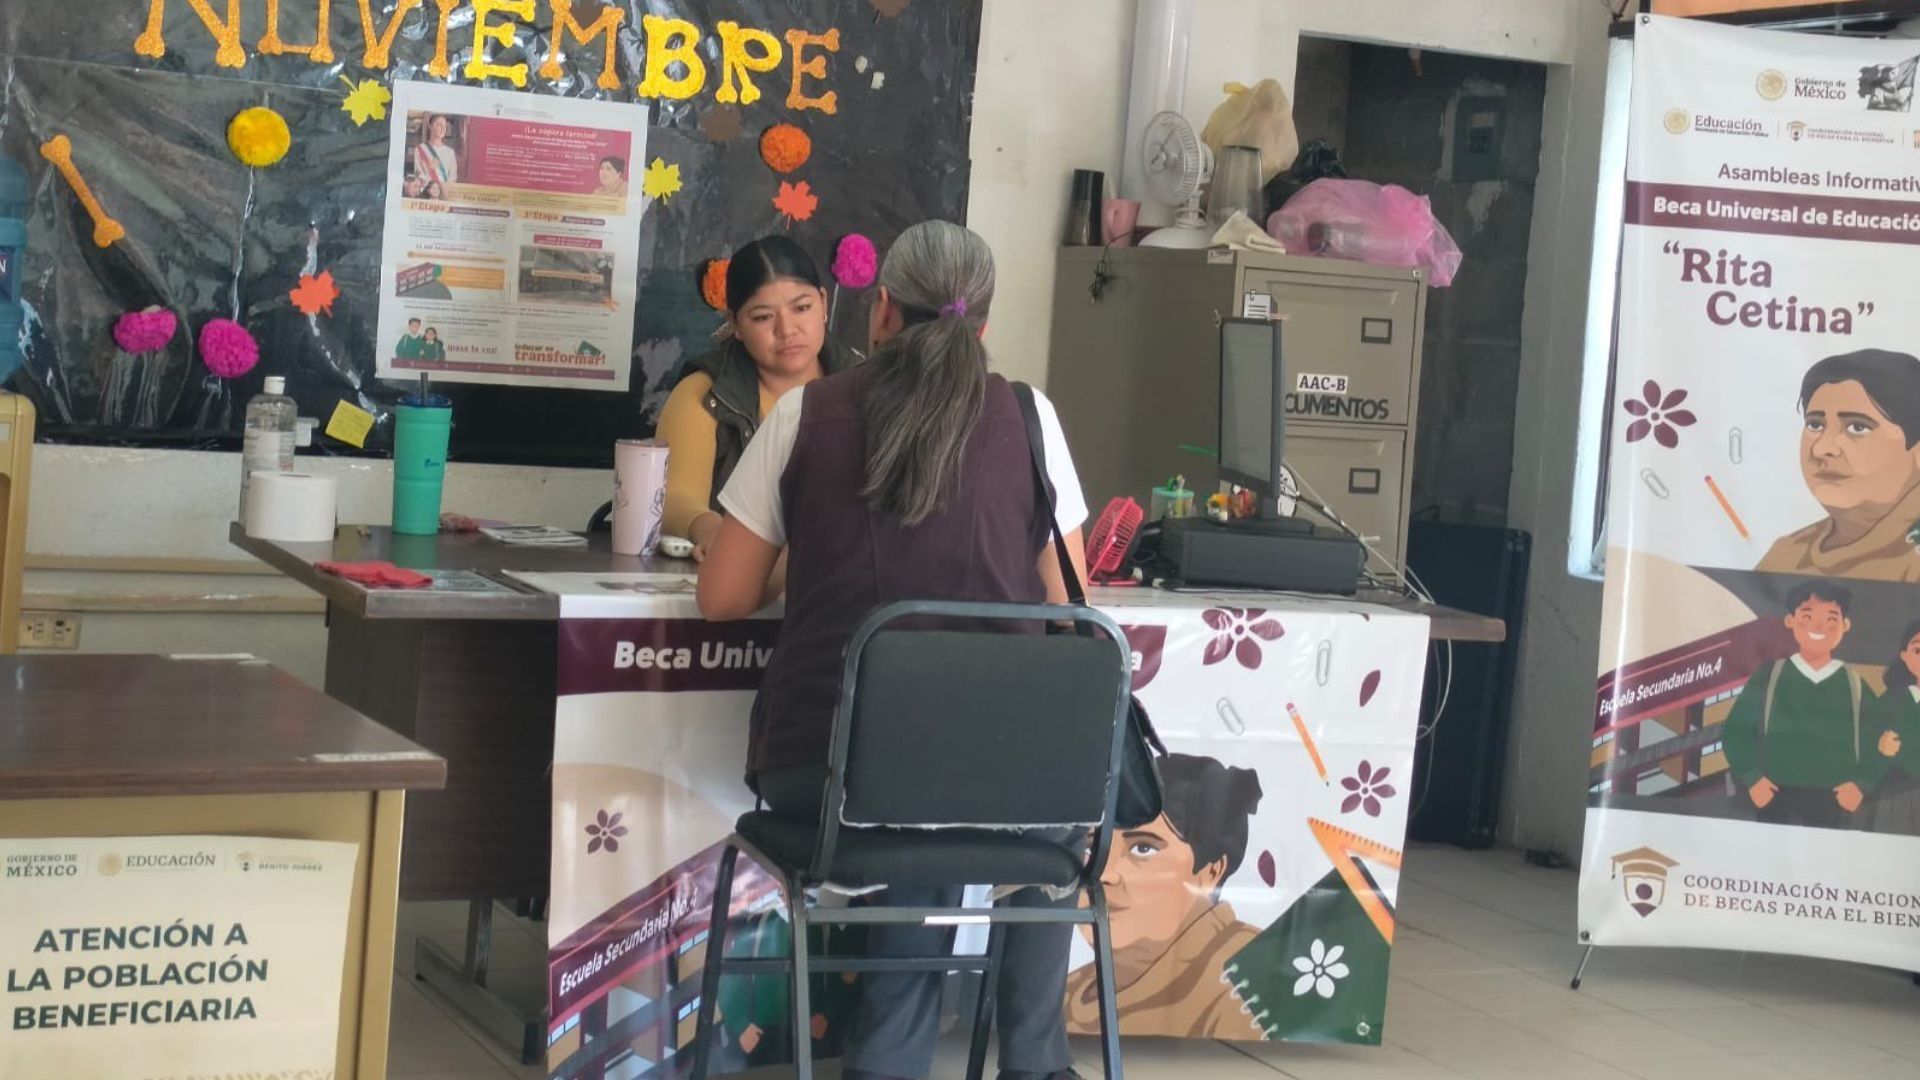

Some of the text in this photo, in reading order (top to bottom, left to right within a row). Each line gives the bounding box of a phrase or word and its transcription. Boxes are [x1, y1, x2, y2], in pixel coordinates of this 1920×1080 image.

[1794, 77, 1846, 88] Gobierno de
[1794, 85, 1847, 100] México
[1695, 115, 1762, 131] Educación
[1718, 163, 1820, 187] Asambleas
[1654, 196, 1920, 231] Beca Universal de Educació
[1662, 240, 1772, 288] “Rita
[1706, 291, 1874, 335] Cetina”
[1299, 375, 1346, 391] AAC-B
[614, 640, 691, 669] Beca
[1599, 656, 1723, 717] Escuela Secundaria No.4
[6, 862, 78, 877] MÉXICO
[7, 853, 78, 864] GOBIERNO DE
[126, 852, 217, 868] EDUCACIÓN
[1683, 874, 1920, 909] COORDINACIÓN NACION
[1684, 893, 1920, 928] DE BECAS PARA EL BIEN
[33, 918, 248, 953] ATENCIÓN A
[559, 952, 602, 998] Escuela
[604, 905, 670, 967] Secundaria
[7, 954, 269, 992] LA POBLACIÓN
[13, 996, 257, 1030] BENEFICIARIA
